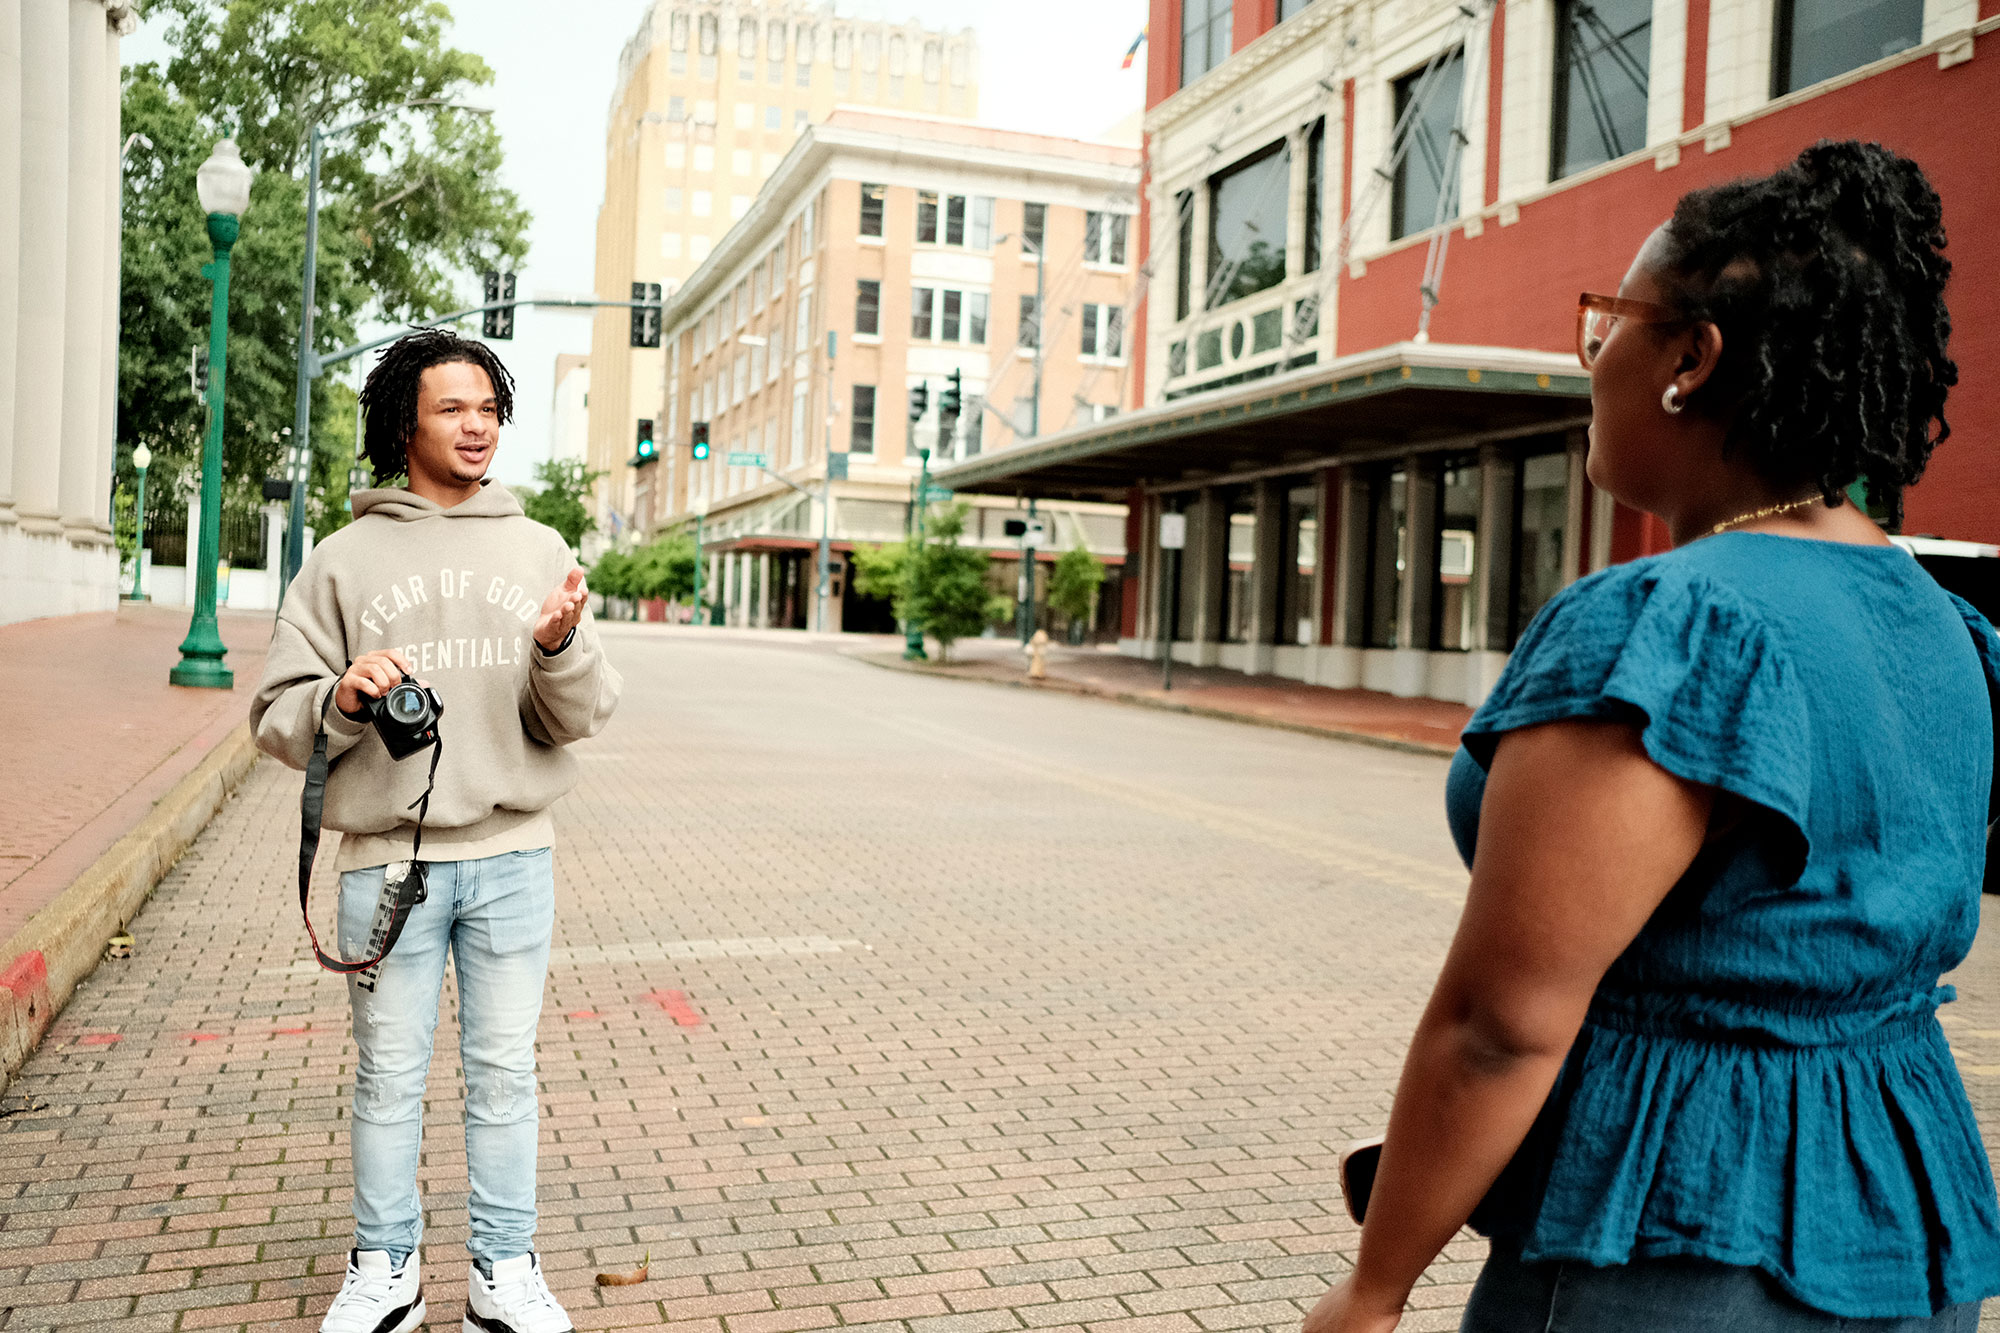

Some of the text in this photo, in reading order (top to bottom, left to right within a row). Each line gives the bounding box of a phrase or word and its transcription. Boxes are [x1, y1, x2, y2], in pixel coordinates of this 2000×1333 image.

[360, 568, 538, 636] FEAR OF GOD
[394, 635, 522, 675] SENTIALS
